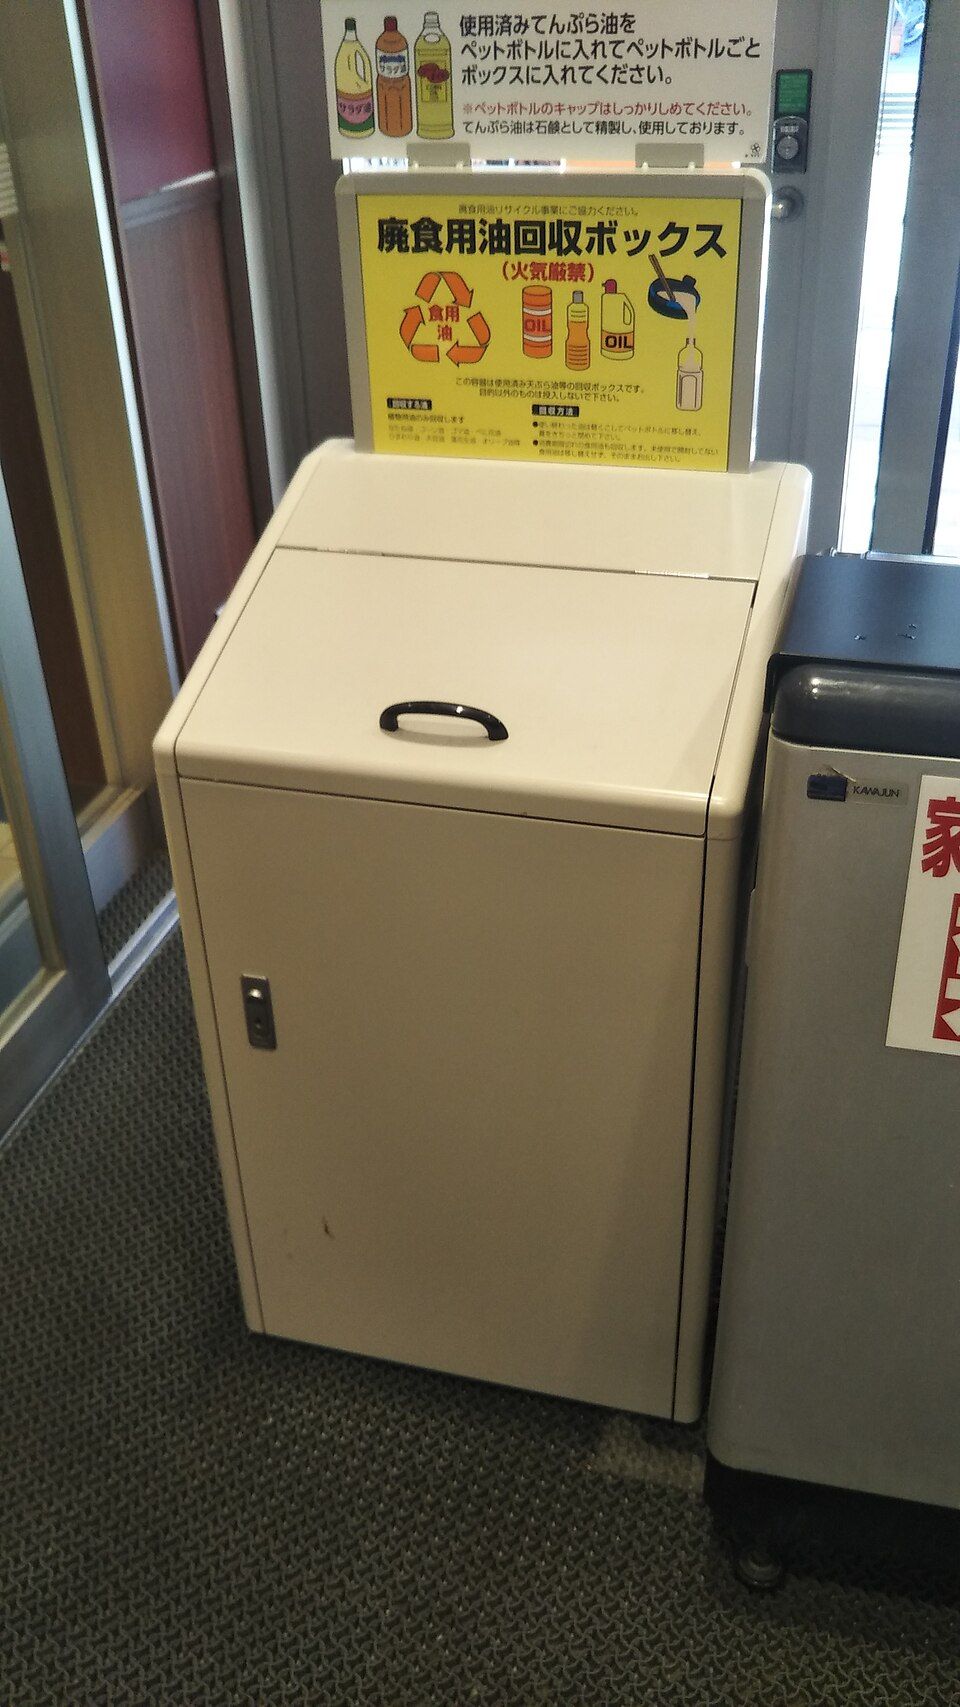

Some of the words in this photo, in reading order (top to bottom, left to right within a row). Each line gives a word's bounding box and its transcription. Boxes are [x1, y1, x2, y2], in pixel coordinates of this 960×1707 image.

[459, 12, 636, 37] 使用済みてんぷら油を
[461, 36, 761, 61] ペットボトルに入れてペットボトルごと
[461, 63, 672, 86] ボックスに入れてください。
[376, 217, 727, 259] 廃食用油回収ボックス
[428, 304, 460, 323] 食用
[524, 317, 551, 335] OIL
[605, 335, 634, 350] OIL
[852, 785, 901, 799] KAWAJUN
